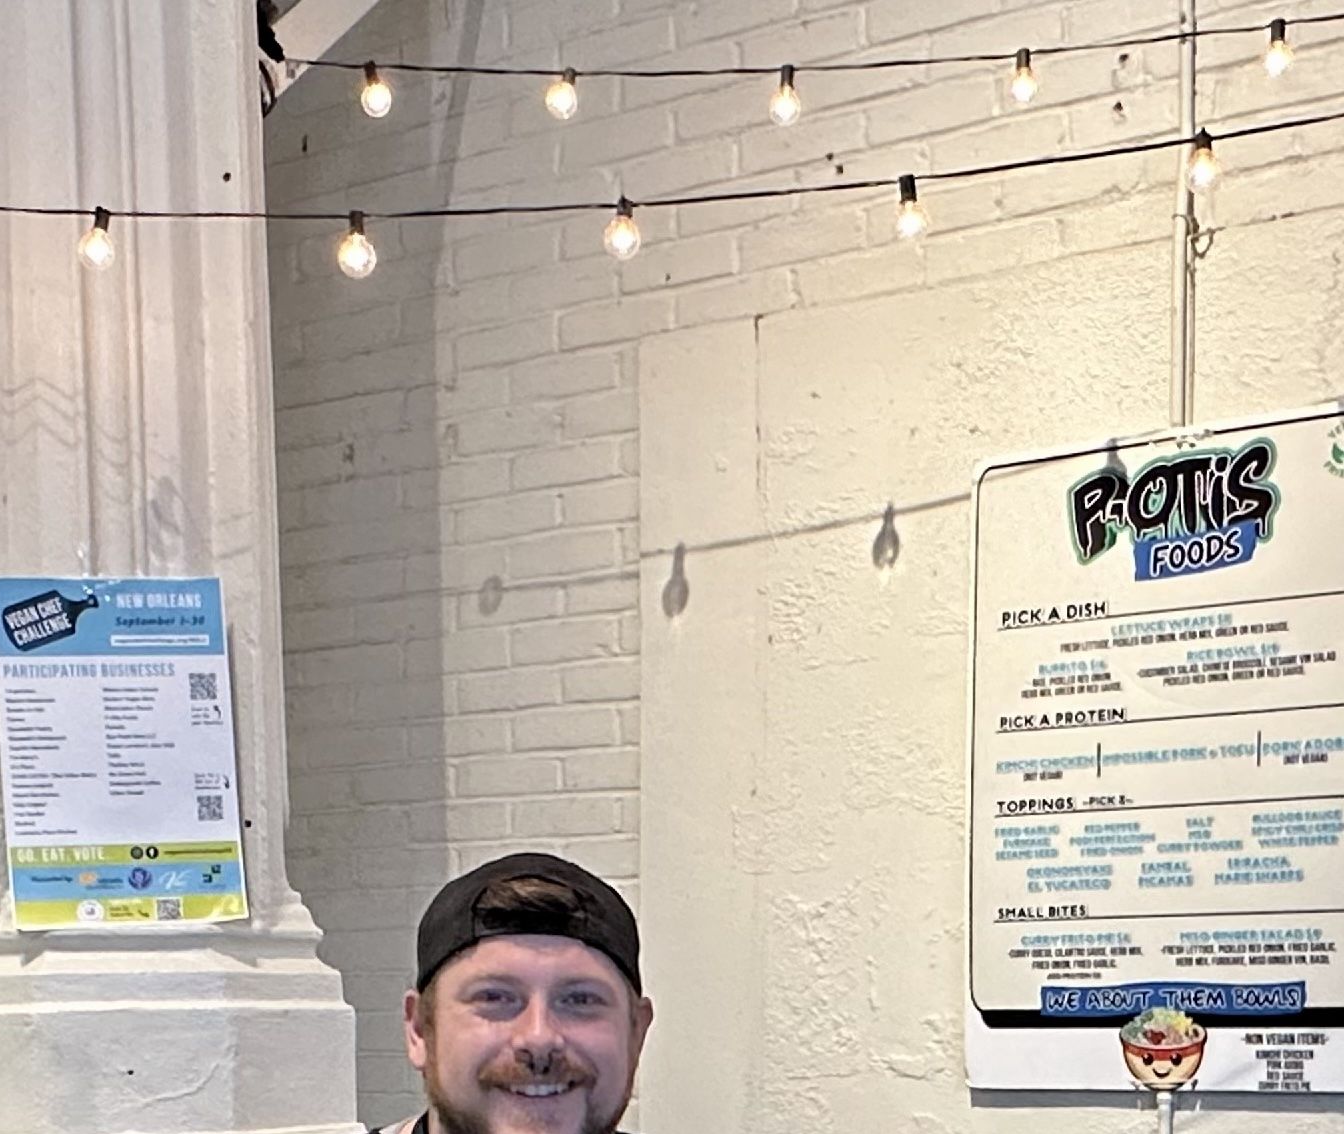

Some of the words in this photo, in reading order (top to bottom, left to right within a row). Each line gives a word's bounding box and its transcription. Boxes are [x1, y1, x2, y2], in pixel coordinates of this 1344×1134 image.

[1151, 530, 1241, 577] FOODS
[116, 593, 145, 609] NEW
[147, 593, 202, 608] ORLEANS
[4, 605, 38, 631] VEGAN
[36, 596, 61, 617] CHEF
[115, 615, 176, 628] September
[1002, 611, 1042, 626] PICK
[1048, 606, 1060, 621] A
[1066, 602, 1107, 619] DISH
[12, 614, 73, 646] CHALLENGE
[2, 662, 98, 679] PARTICIPATING
[101, 661, 176, 678] BUSINESSES
[1000, 715, 1035, 729] PICK
[1039, 714, 1050, 726] A
[1055, 708, 1125, 725] PROTEIN
[997, 797, 1075, 813] TOPPINGS
[1027, 881, 1043, 893] EL
[1044, 878, 1112, 893] YUCATECO
[997, 906, 1044, 920] SMALL
[1048, 905, 1087, 918] BITES
[1046, 991, 1081, 1012] WE
[1087, 988, 1153, 1011] ABOUT
[1160, 988, 1227, 1009] THEM
[1231, 987, 1302, 1009] BOWLS
